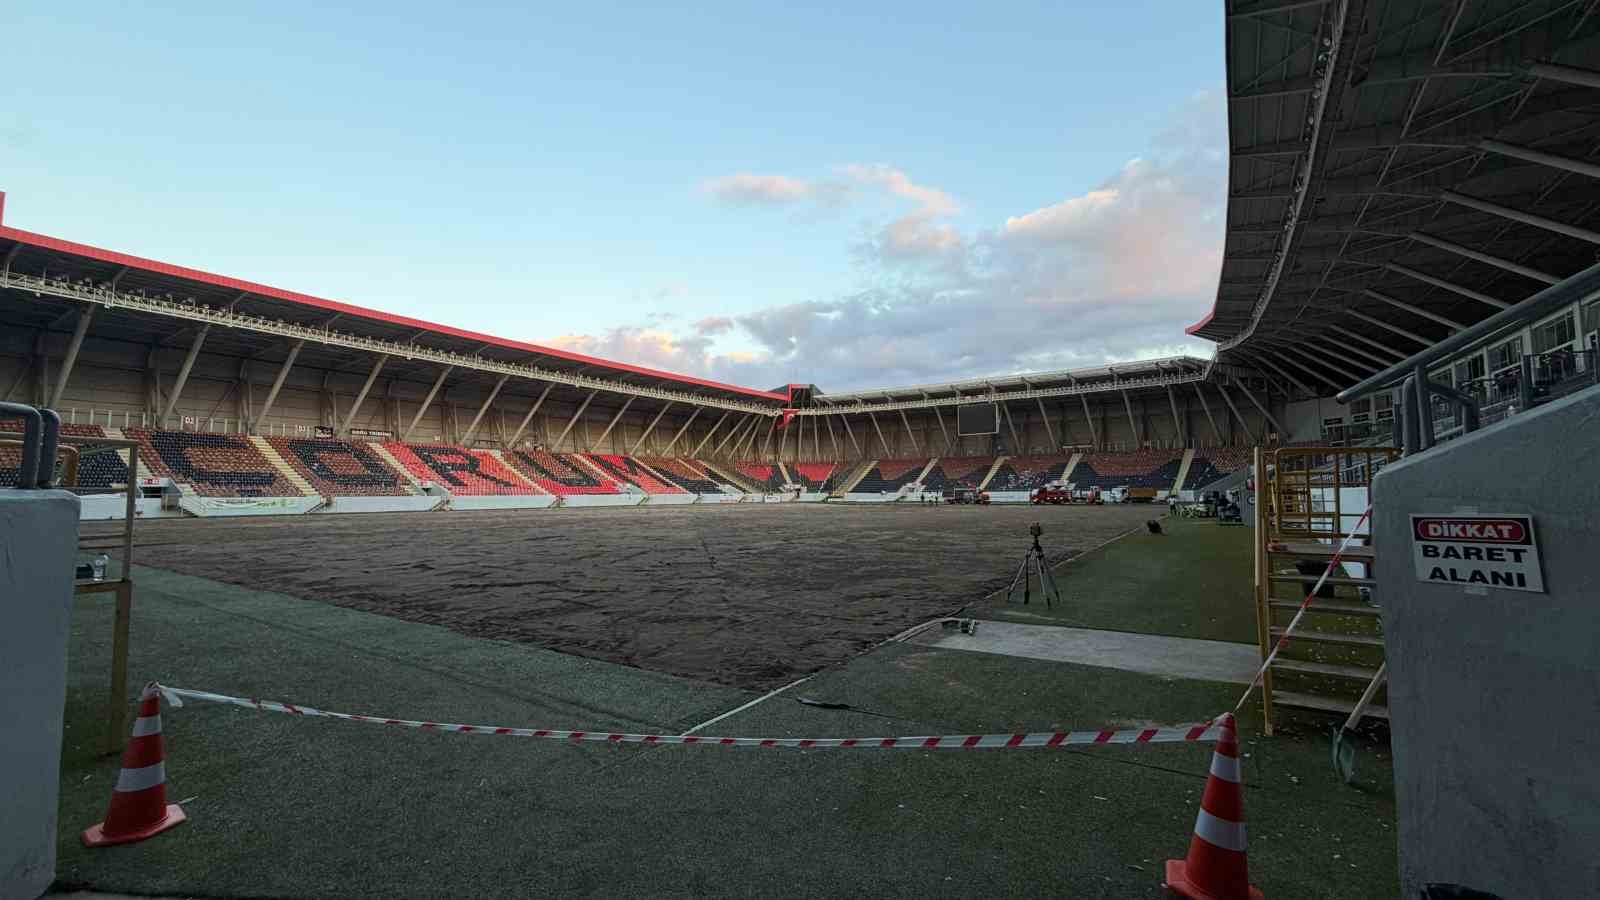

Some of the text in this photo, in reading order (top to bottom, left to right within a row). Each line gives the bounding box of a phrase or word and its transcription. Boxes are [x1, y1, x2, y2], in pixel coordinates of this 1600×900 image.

[1427, 520, 1513, 538] DİKKAT
[1421, 544, 1528, 563] BARET
[1428, 566, 1527, 587] ALANI
